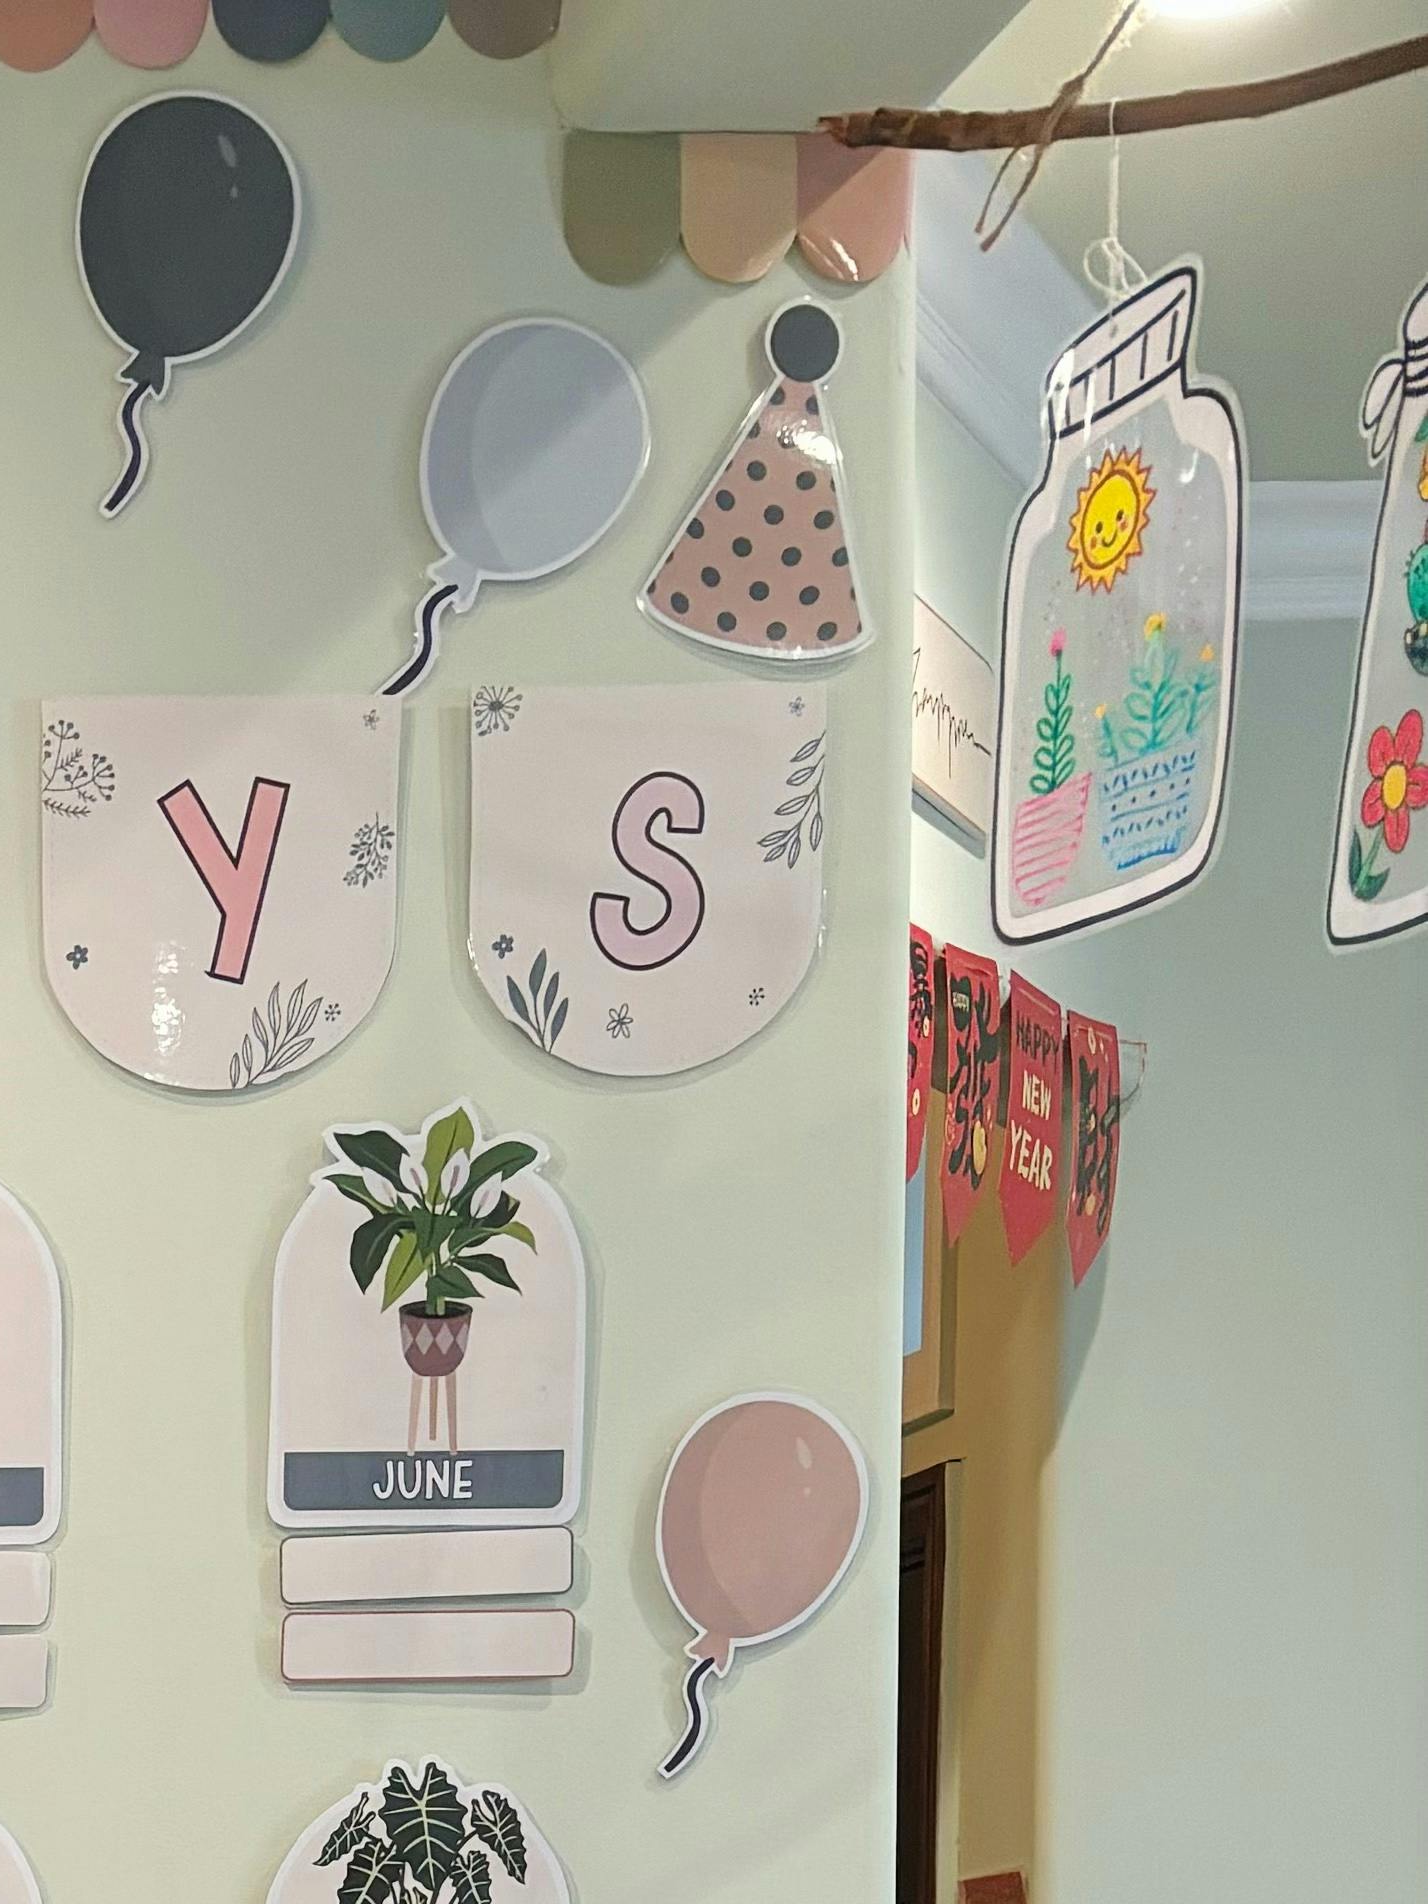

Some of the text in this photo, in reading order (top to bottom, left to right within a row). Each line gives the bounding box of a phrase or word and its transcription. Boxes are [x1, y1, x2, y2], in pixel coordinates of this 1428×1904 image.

[1016, 1015, 1059, 1068] HAPPY
[1022, 1069, 1052, 1121] NEW
[1011, 1119, 1053, 1191] YEAR
[373, 1459, 473, 1500] JUNE
